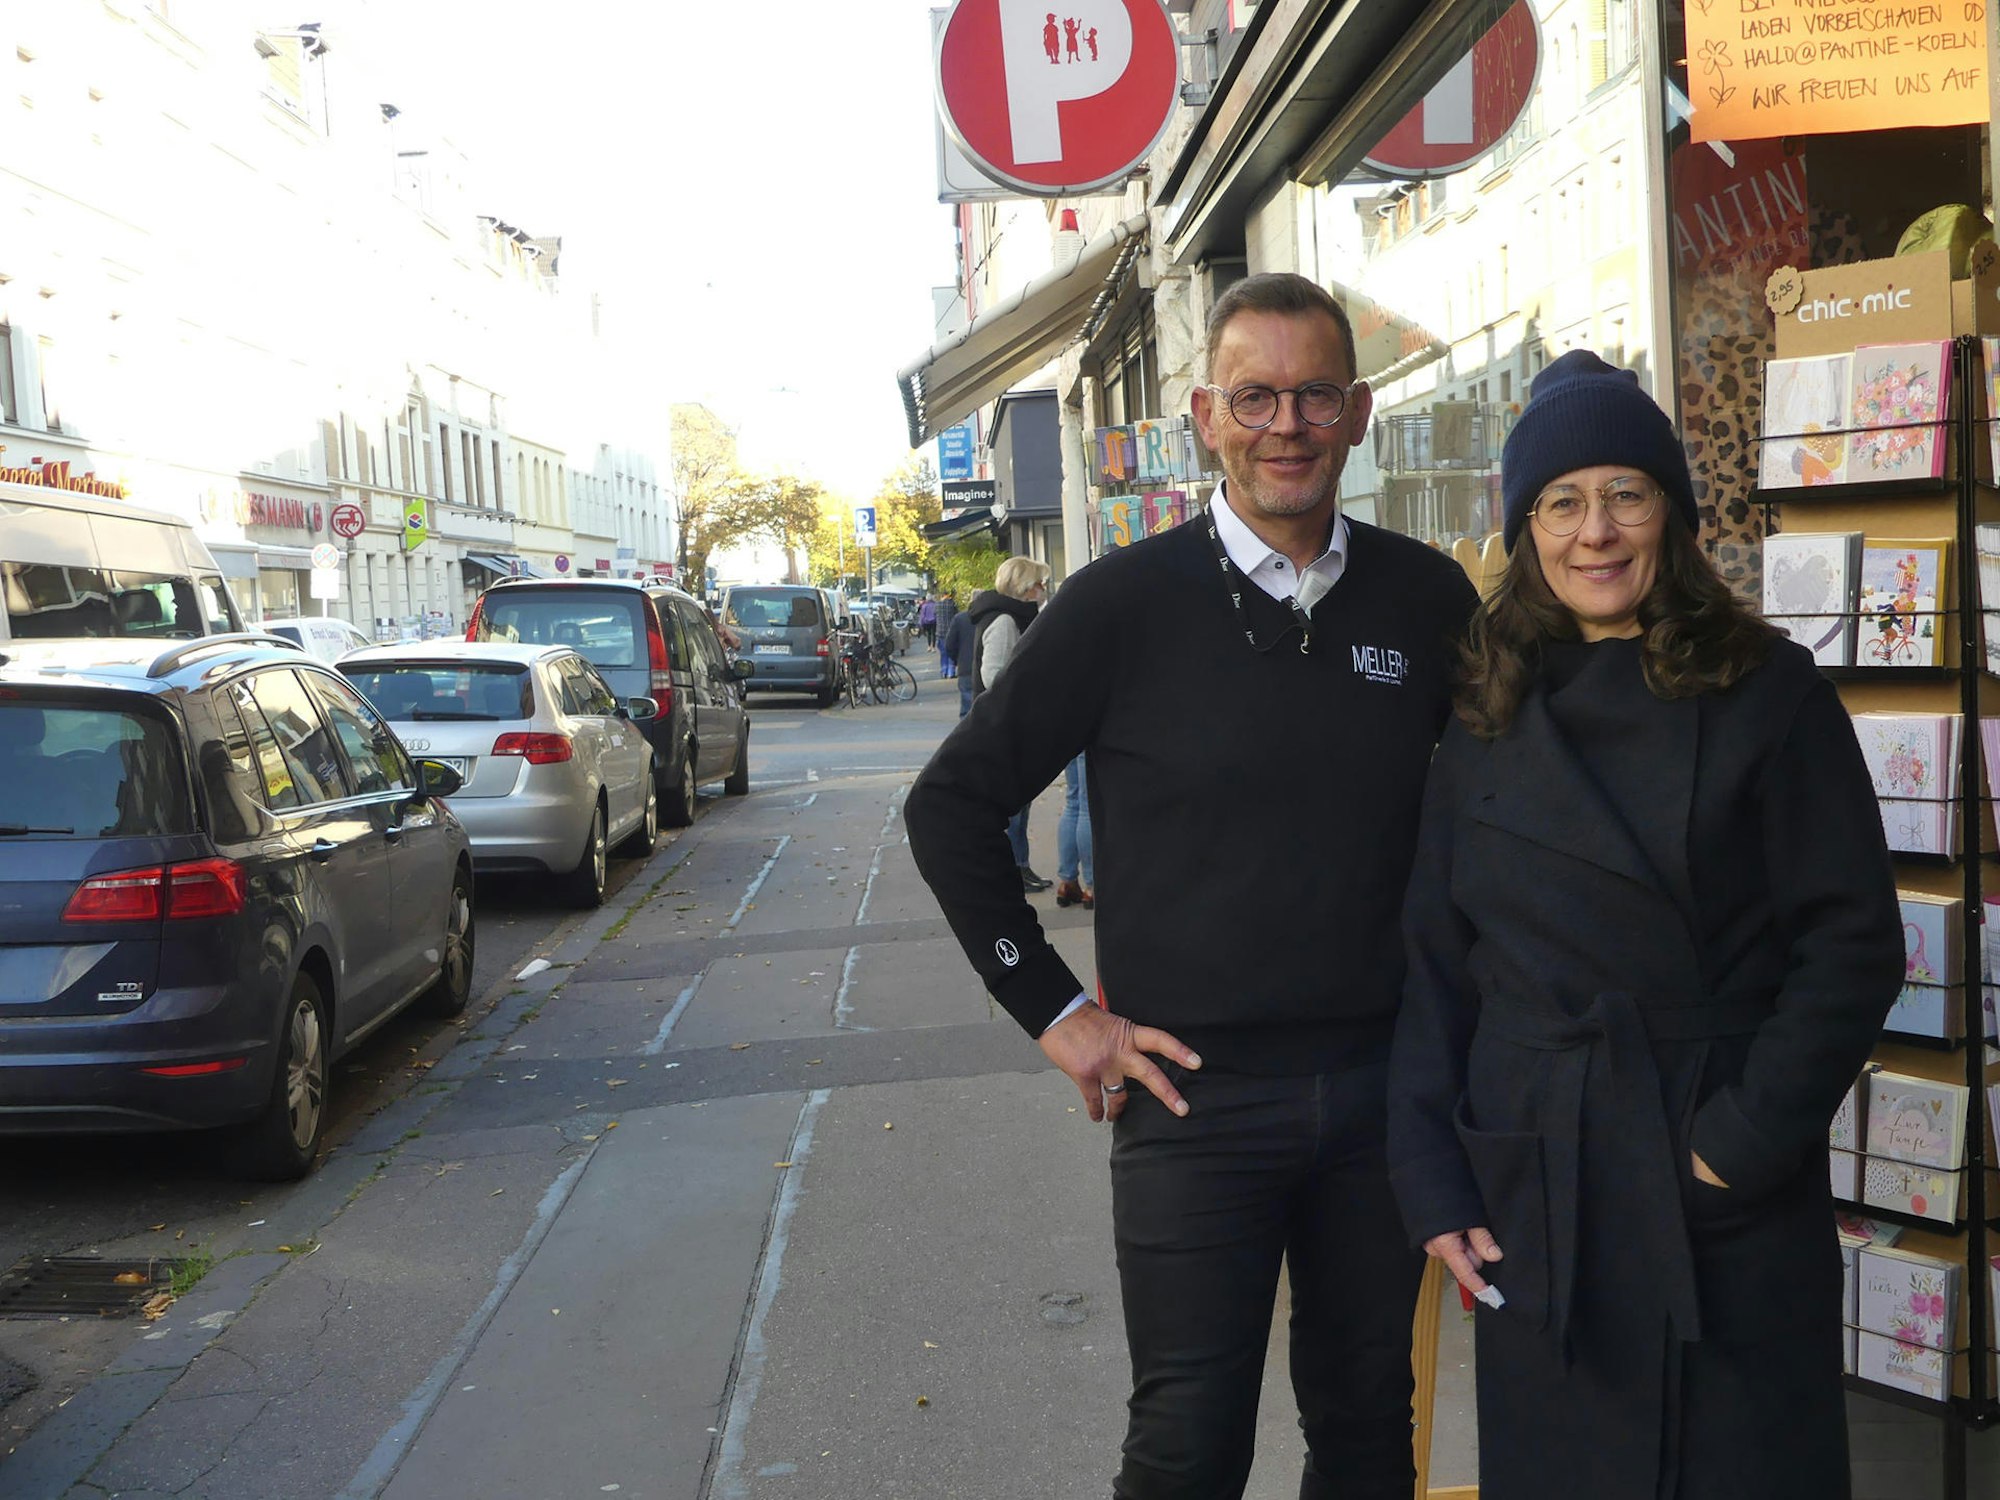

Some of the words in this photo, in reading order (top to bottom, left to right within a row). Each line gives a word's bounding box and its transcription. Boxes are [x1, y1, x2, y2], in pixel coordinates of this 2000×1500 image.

[1741, 16, 1791, 40] LADEN
[1752, 83, 1789, 109] WIR
[1799, 77, 1877, 103] FREUEN
[1896, 73, 1931, 96] UNS
[1942, 67, 1980, 92] AUF
[1770, 279, 1794, 302] 2,95
[1351, 645, 1403, 679] MELLER
[116, 982, 144, 992] TDI
